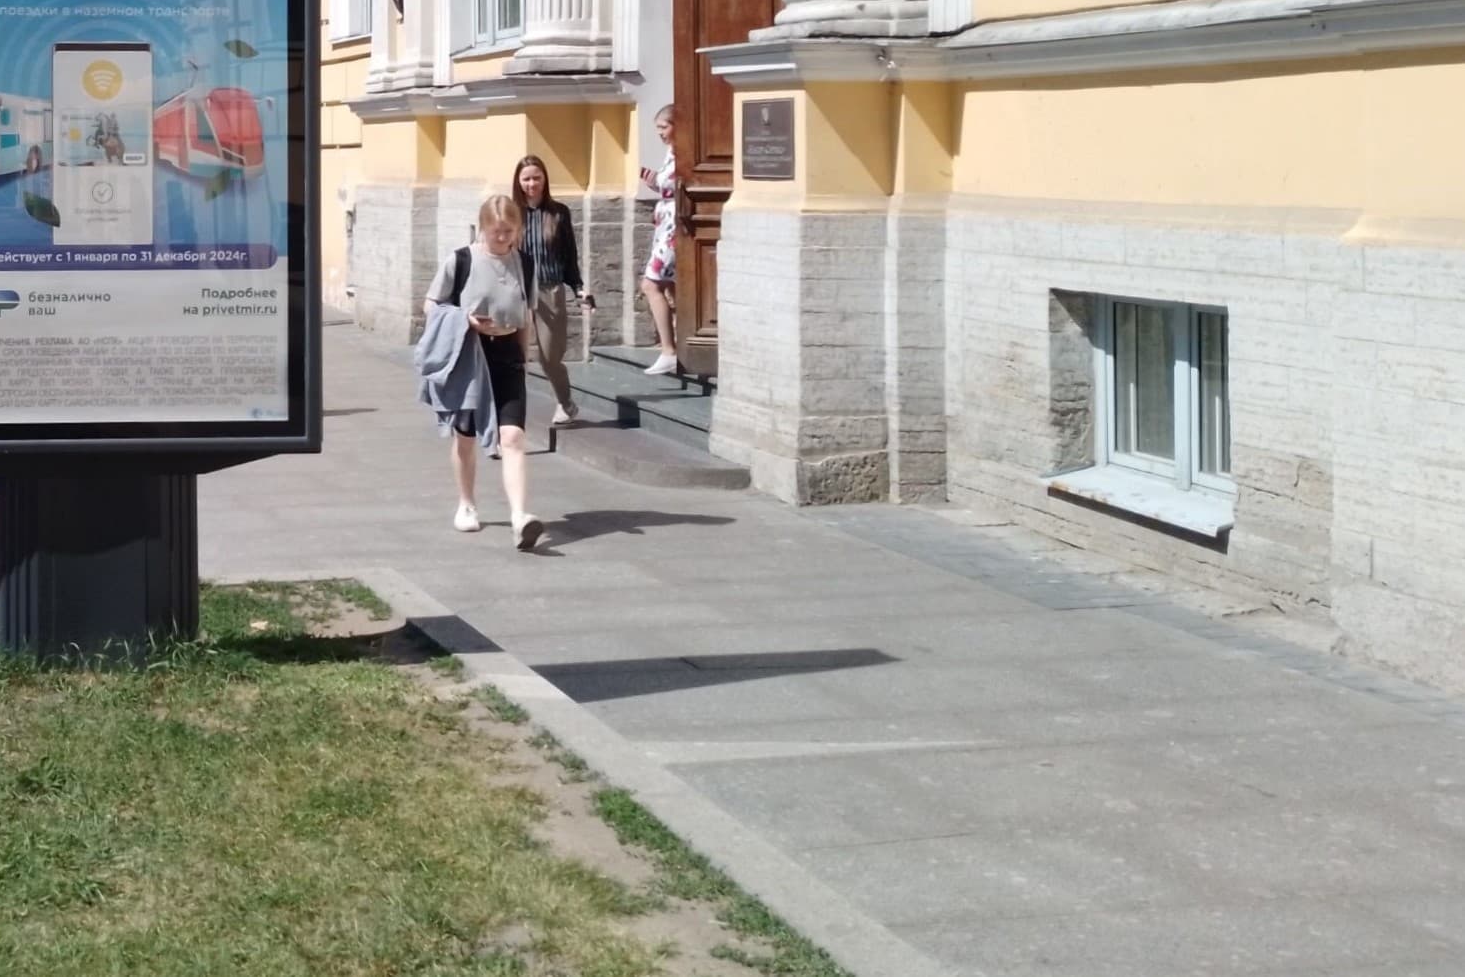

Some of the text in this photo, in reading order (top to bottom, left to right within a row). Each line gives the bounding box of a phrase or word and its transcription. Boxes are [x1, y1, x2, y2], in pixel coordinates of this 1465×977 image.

[74, 5, 143, 16] наземном
[56, 254, 63, 262] с
[66, 252, 71, 261] 1
[74, 253, 118, 264] января
[121, 253, 137, 262] по
[140, 251, 152, 261] 31
[155, 250, 206, 263] декабря
[28, 292, 111, 303] безналично
[201, 287, 277, 300] Подробнее
[28, 308, 56, 317] ваш
[182, 303, 278, 318] на privetmir.ru
